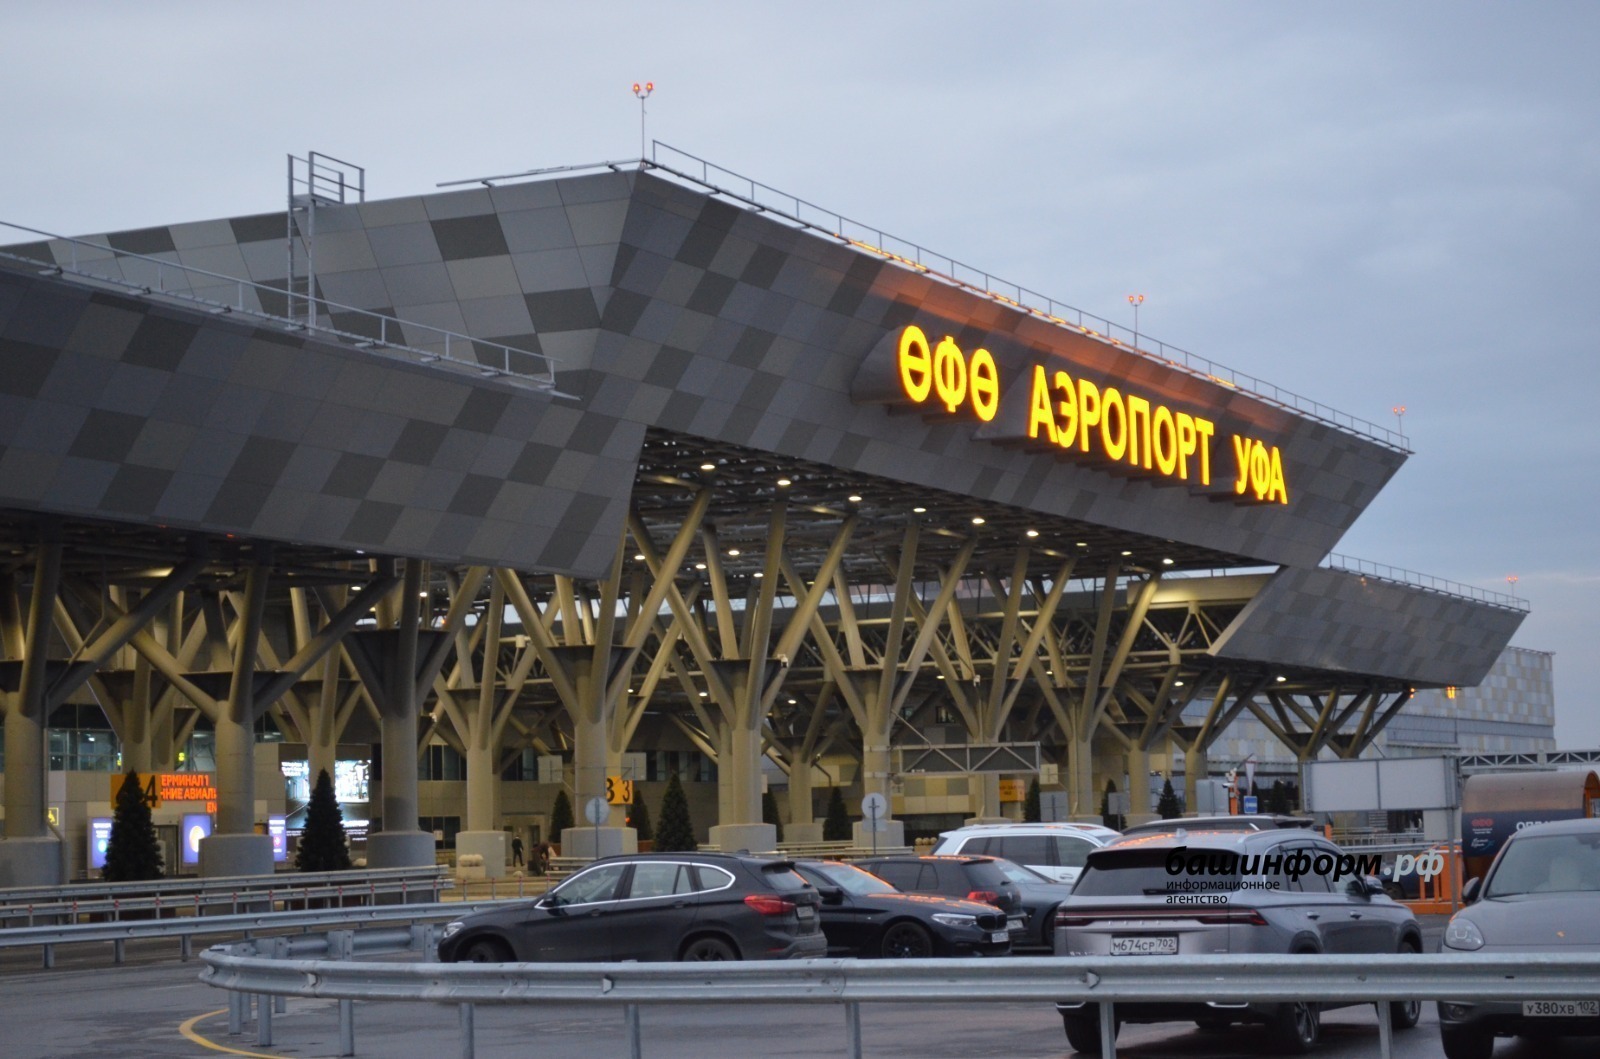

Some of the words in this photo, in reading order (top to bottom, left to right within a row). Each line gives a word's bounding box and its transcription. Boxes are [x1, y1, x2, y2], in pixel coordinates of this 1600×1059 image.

[898, 324, 999, 422] ӨФӨ
[1029, 364, 1215, 486] АЭРОПОРТ
[1233, 434, 1288, 505] УФА
[160, 774, 203, 786] ЕРМИНАЛ
[204, 774, 209, 786] 1
[143, 775, 158, 807] 4
[622, 780, 630, 802] 3
[1113, 939, 1155, 951] М674СР
[1157, 938, 1174, 948] 702
[1577, 1001, 1596, 1011] 102
